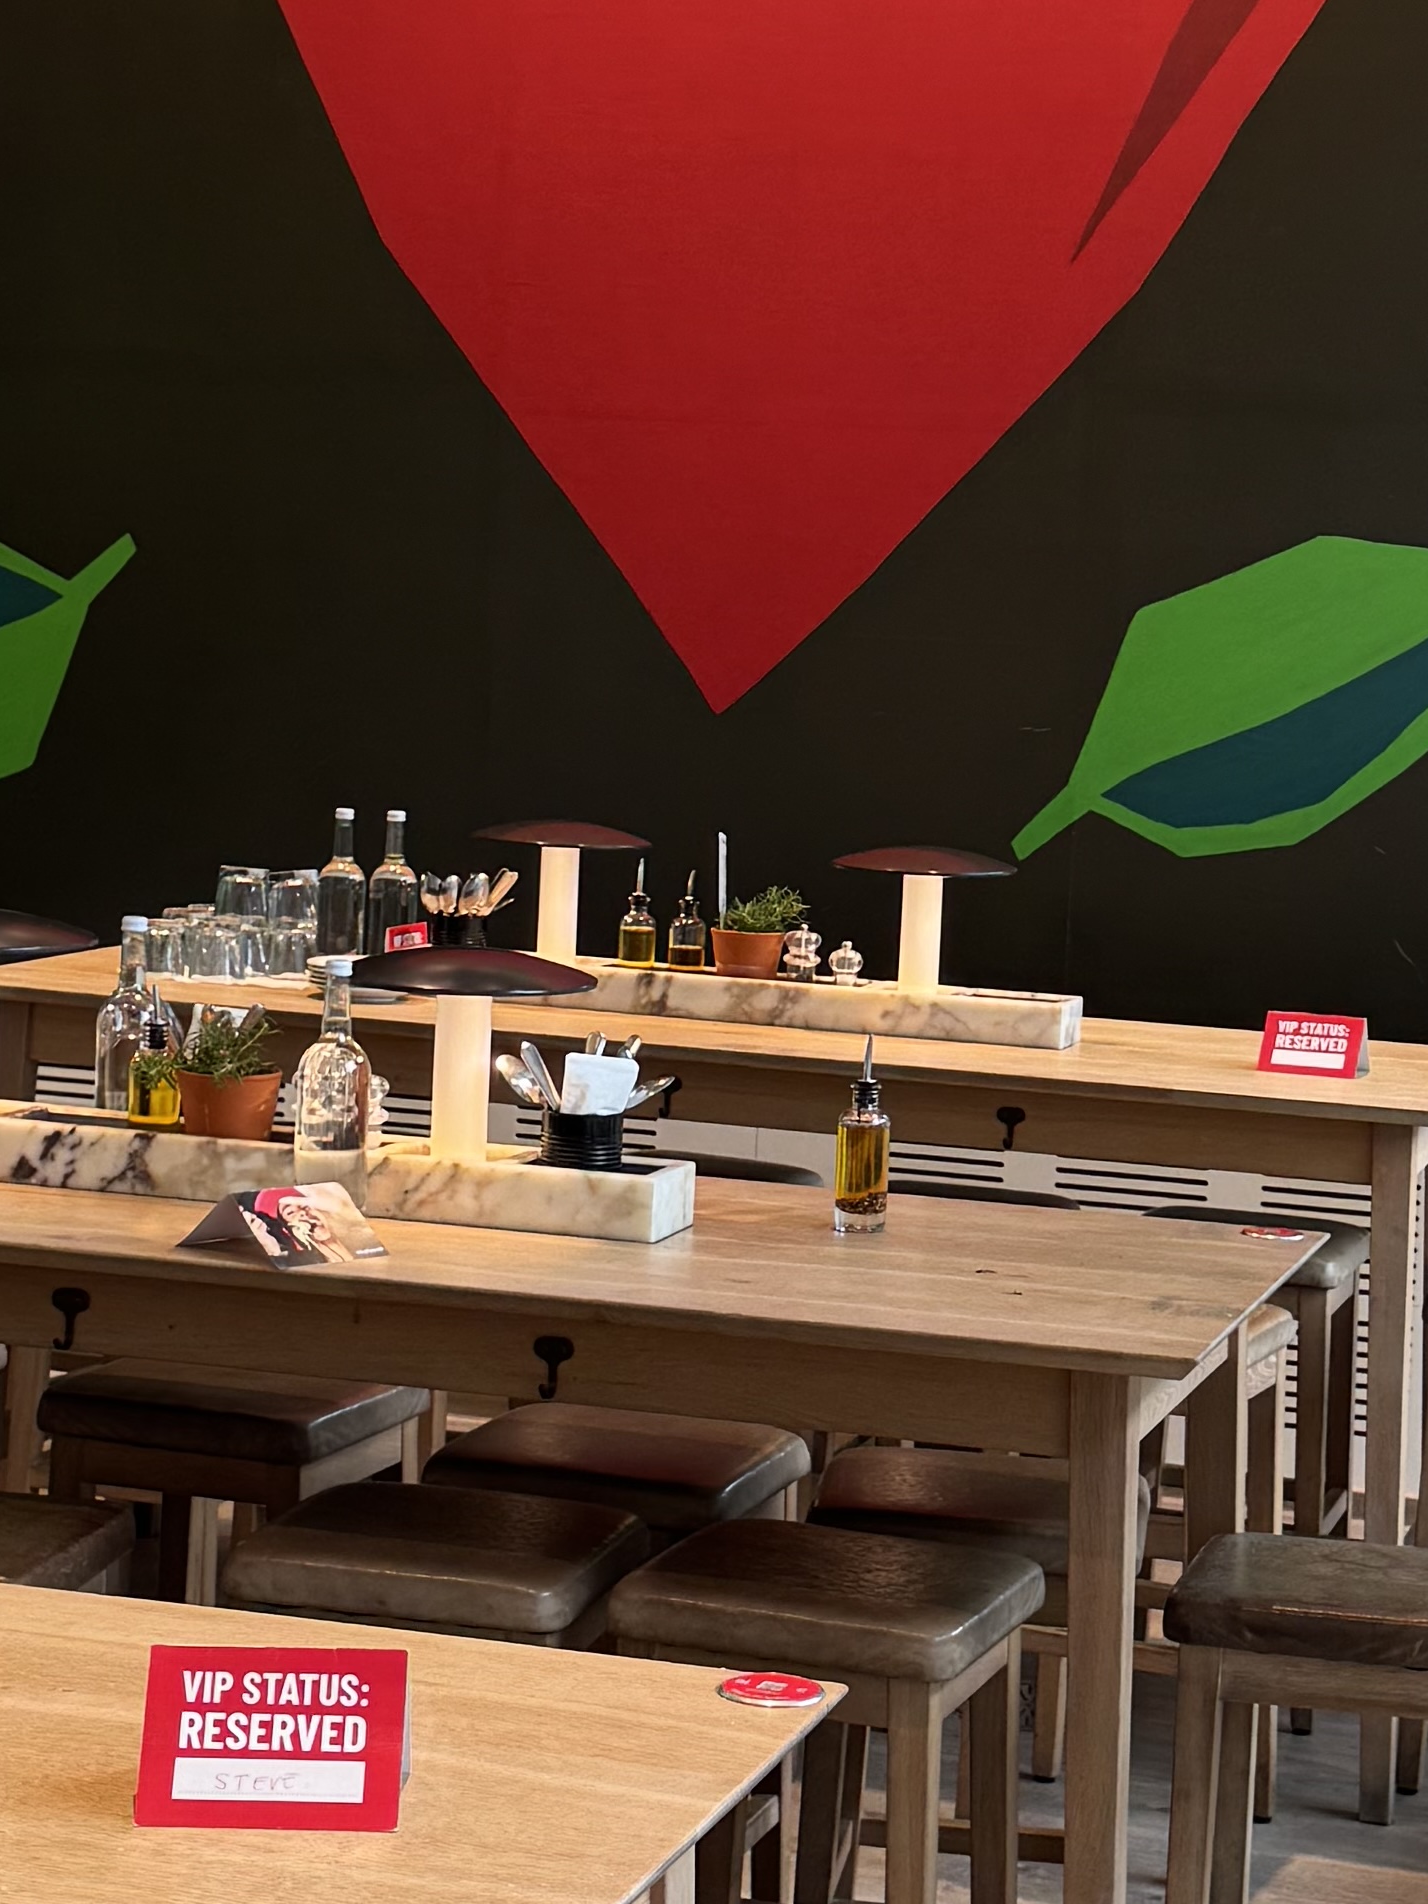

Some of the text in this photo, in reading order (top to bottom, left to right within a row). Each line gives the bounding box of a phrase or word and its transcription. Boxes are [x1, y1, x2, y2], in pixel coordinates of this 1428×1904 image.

[1278, 1020, 1350, 1037] VIP STATUS:
[1275, 1034, 1348, 1052] RESERVED
[182, 1670, 370, 1707] VIP STATUS:
[178, 1711, 367, 1753] RESERVED
